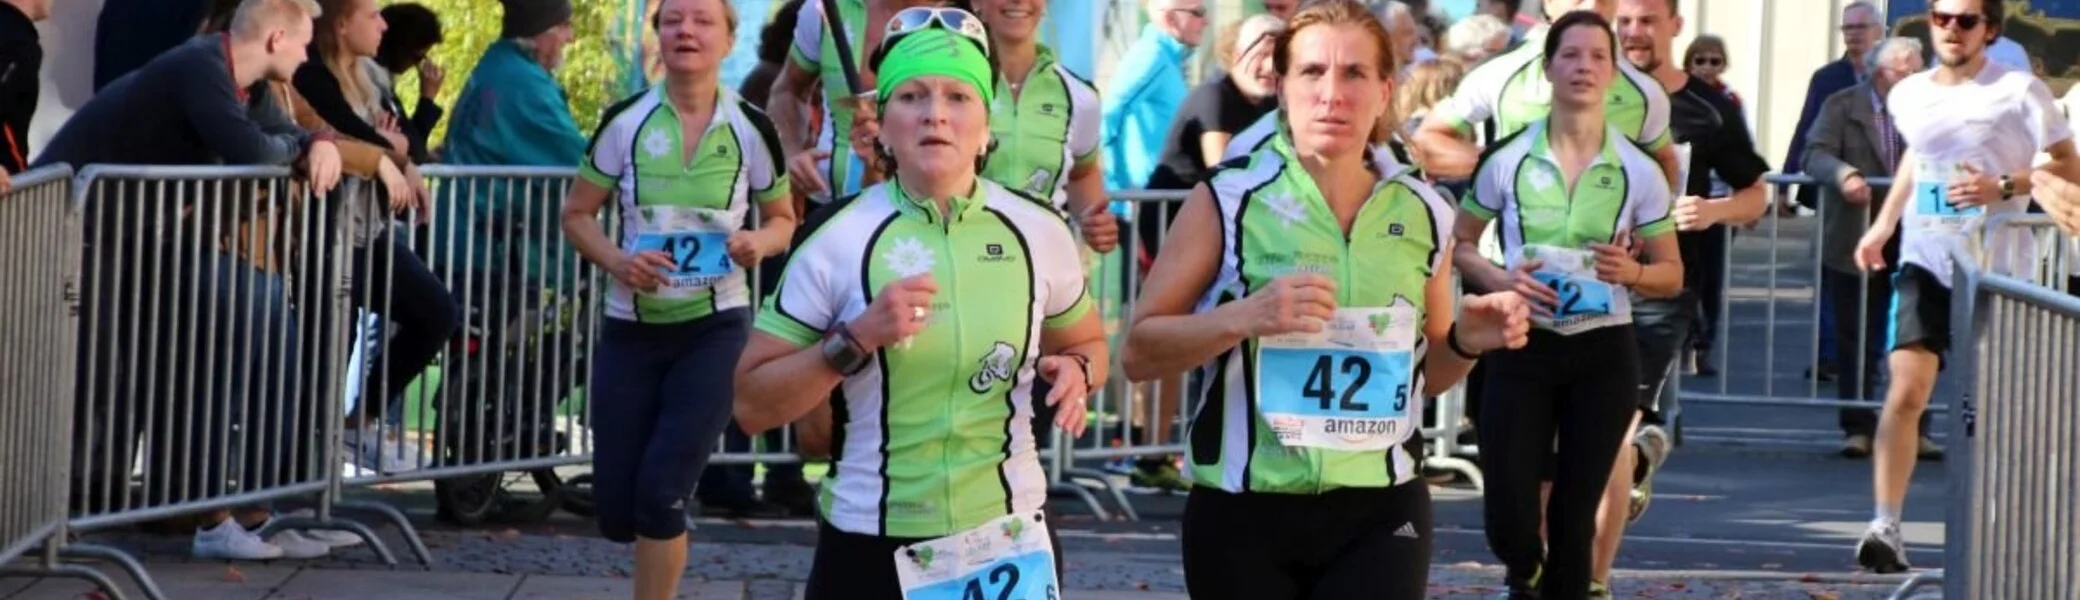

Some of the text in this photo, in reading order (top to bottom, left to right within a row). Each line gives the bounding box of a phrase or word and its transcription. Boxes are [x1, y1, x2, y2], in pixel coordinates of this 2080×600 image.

[1302, 354, 1408, 412] 42 5
[1324, 418, 1397, 435] amazon
